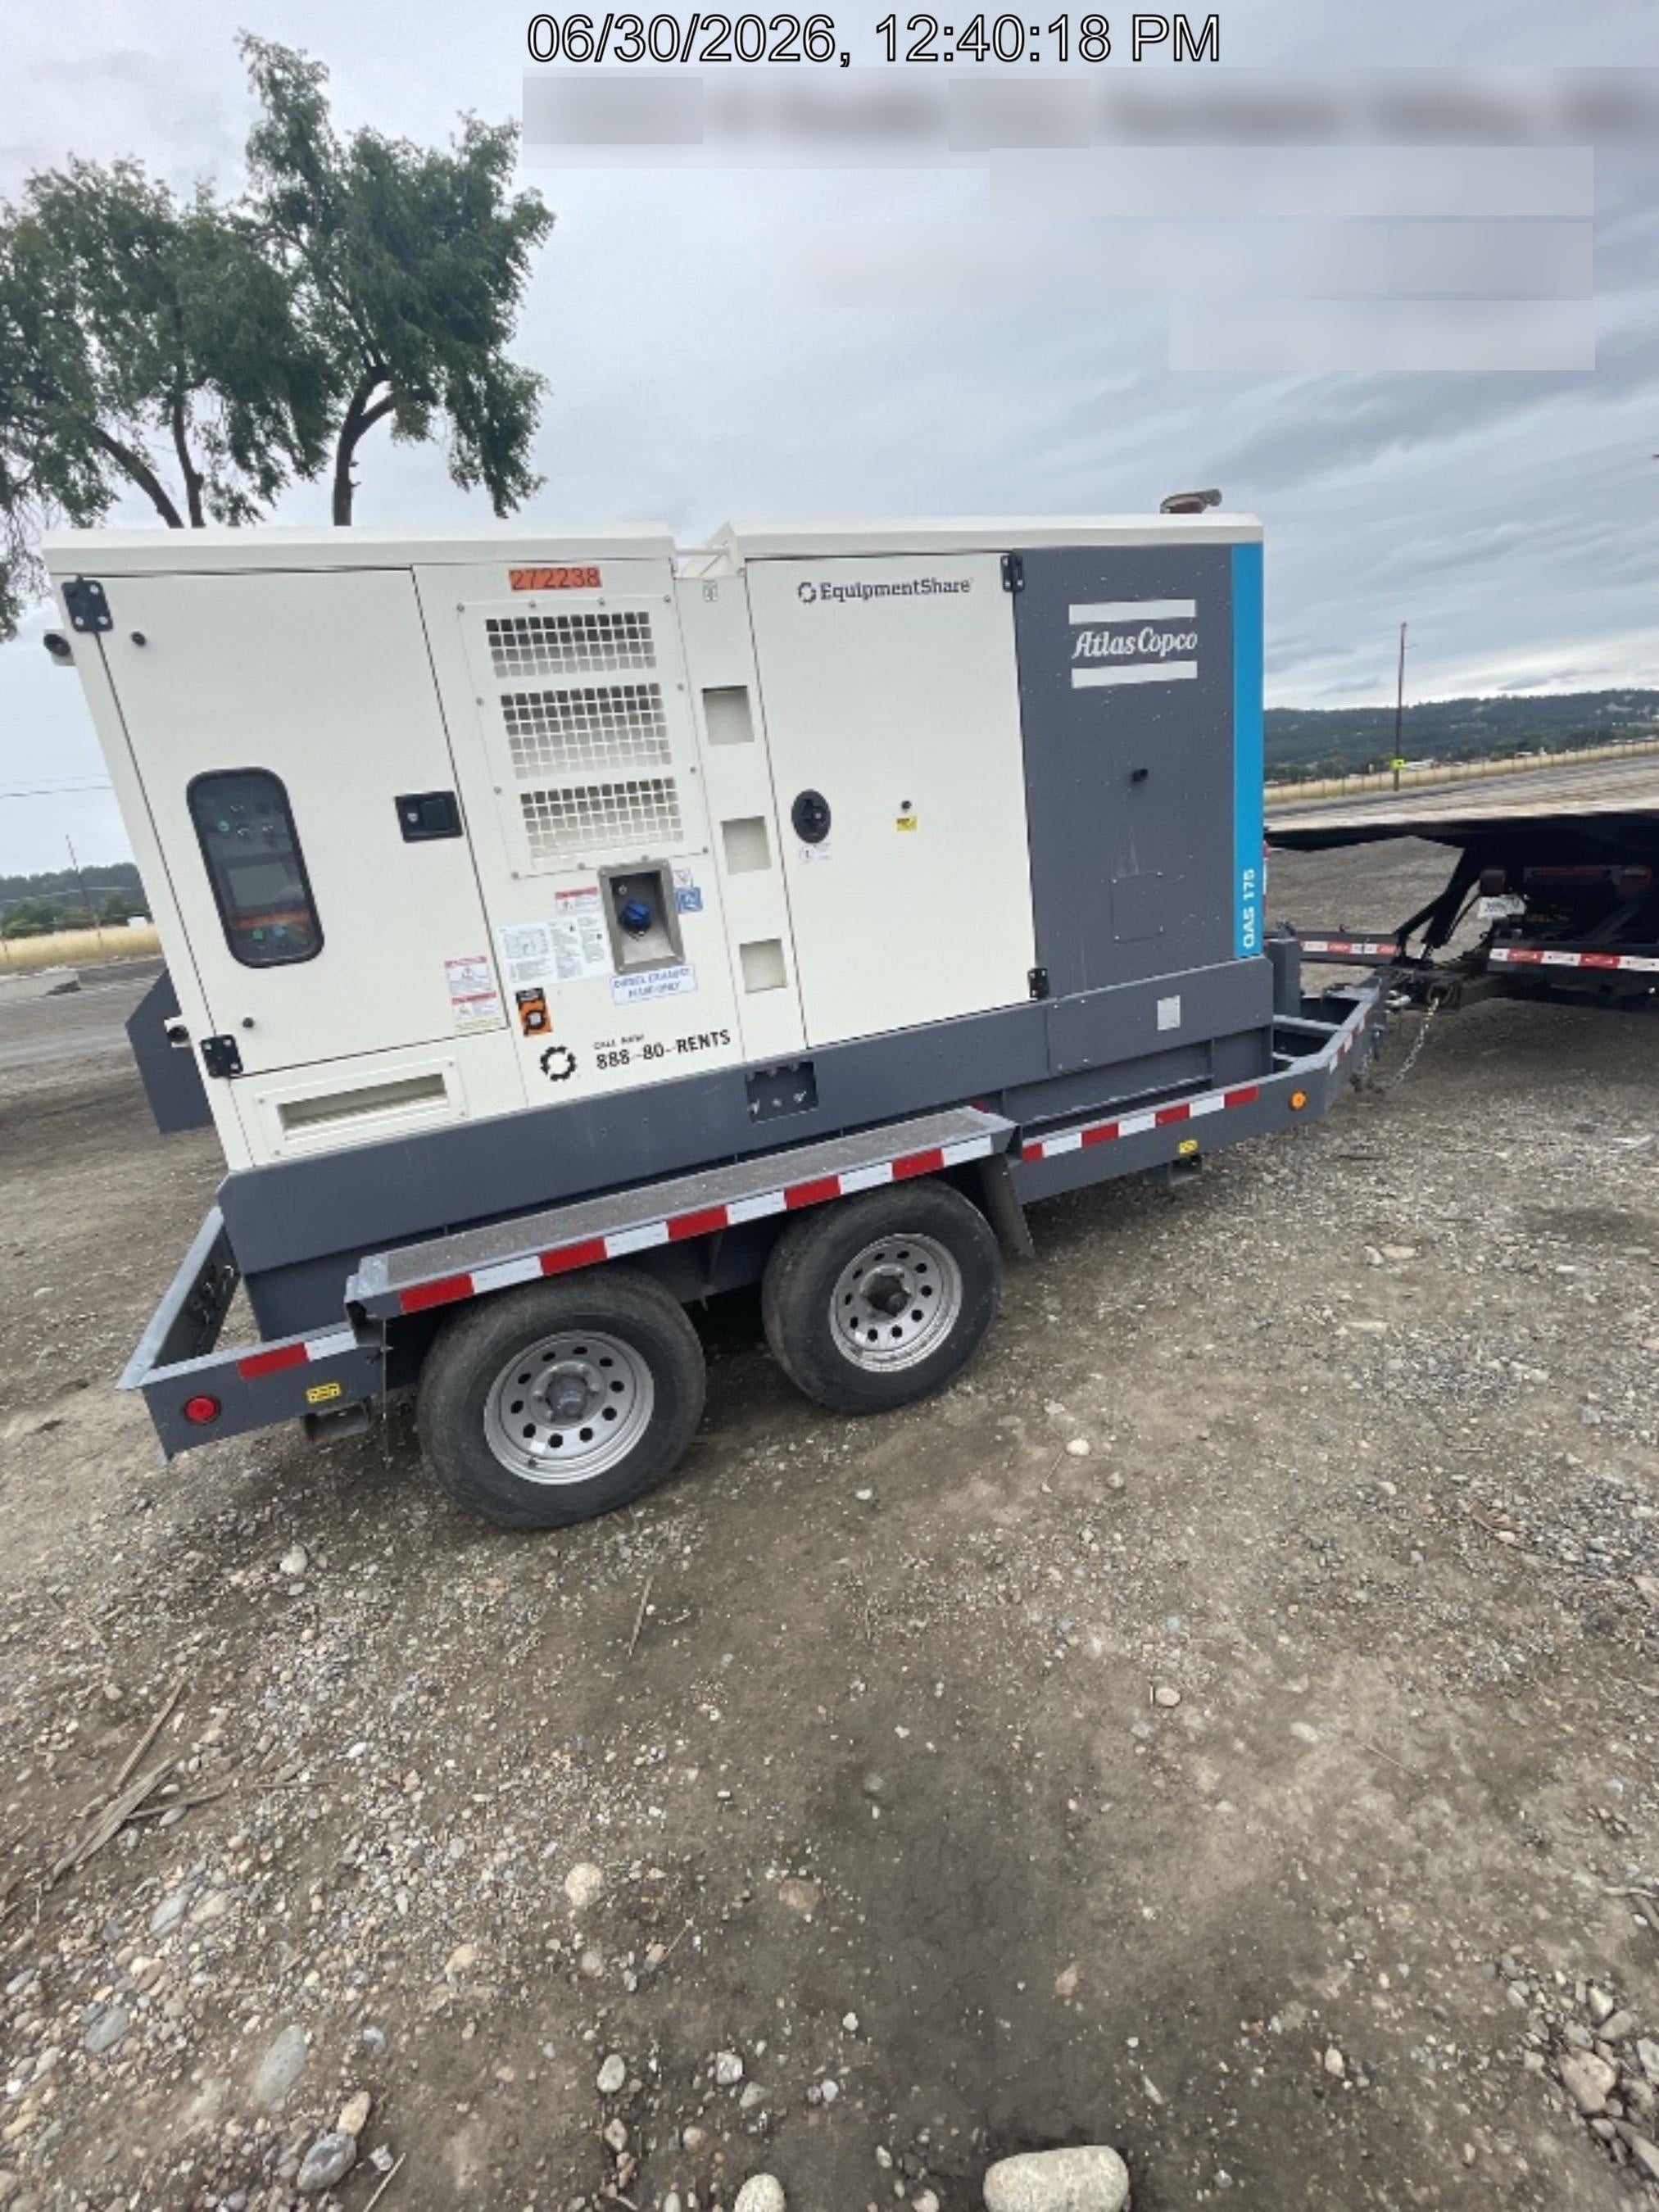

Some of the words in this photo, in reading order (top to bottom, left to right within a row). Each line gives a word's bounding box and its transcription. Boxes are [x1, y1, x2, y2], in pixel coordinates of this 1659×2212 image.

[511, 567, 600, 590] 272238
[819, 576, 973, 602] EquipmentShare
[1243, 868, 1255, 900] 175
[1243, 906, 1255, 949] QAS
